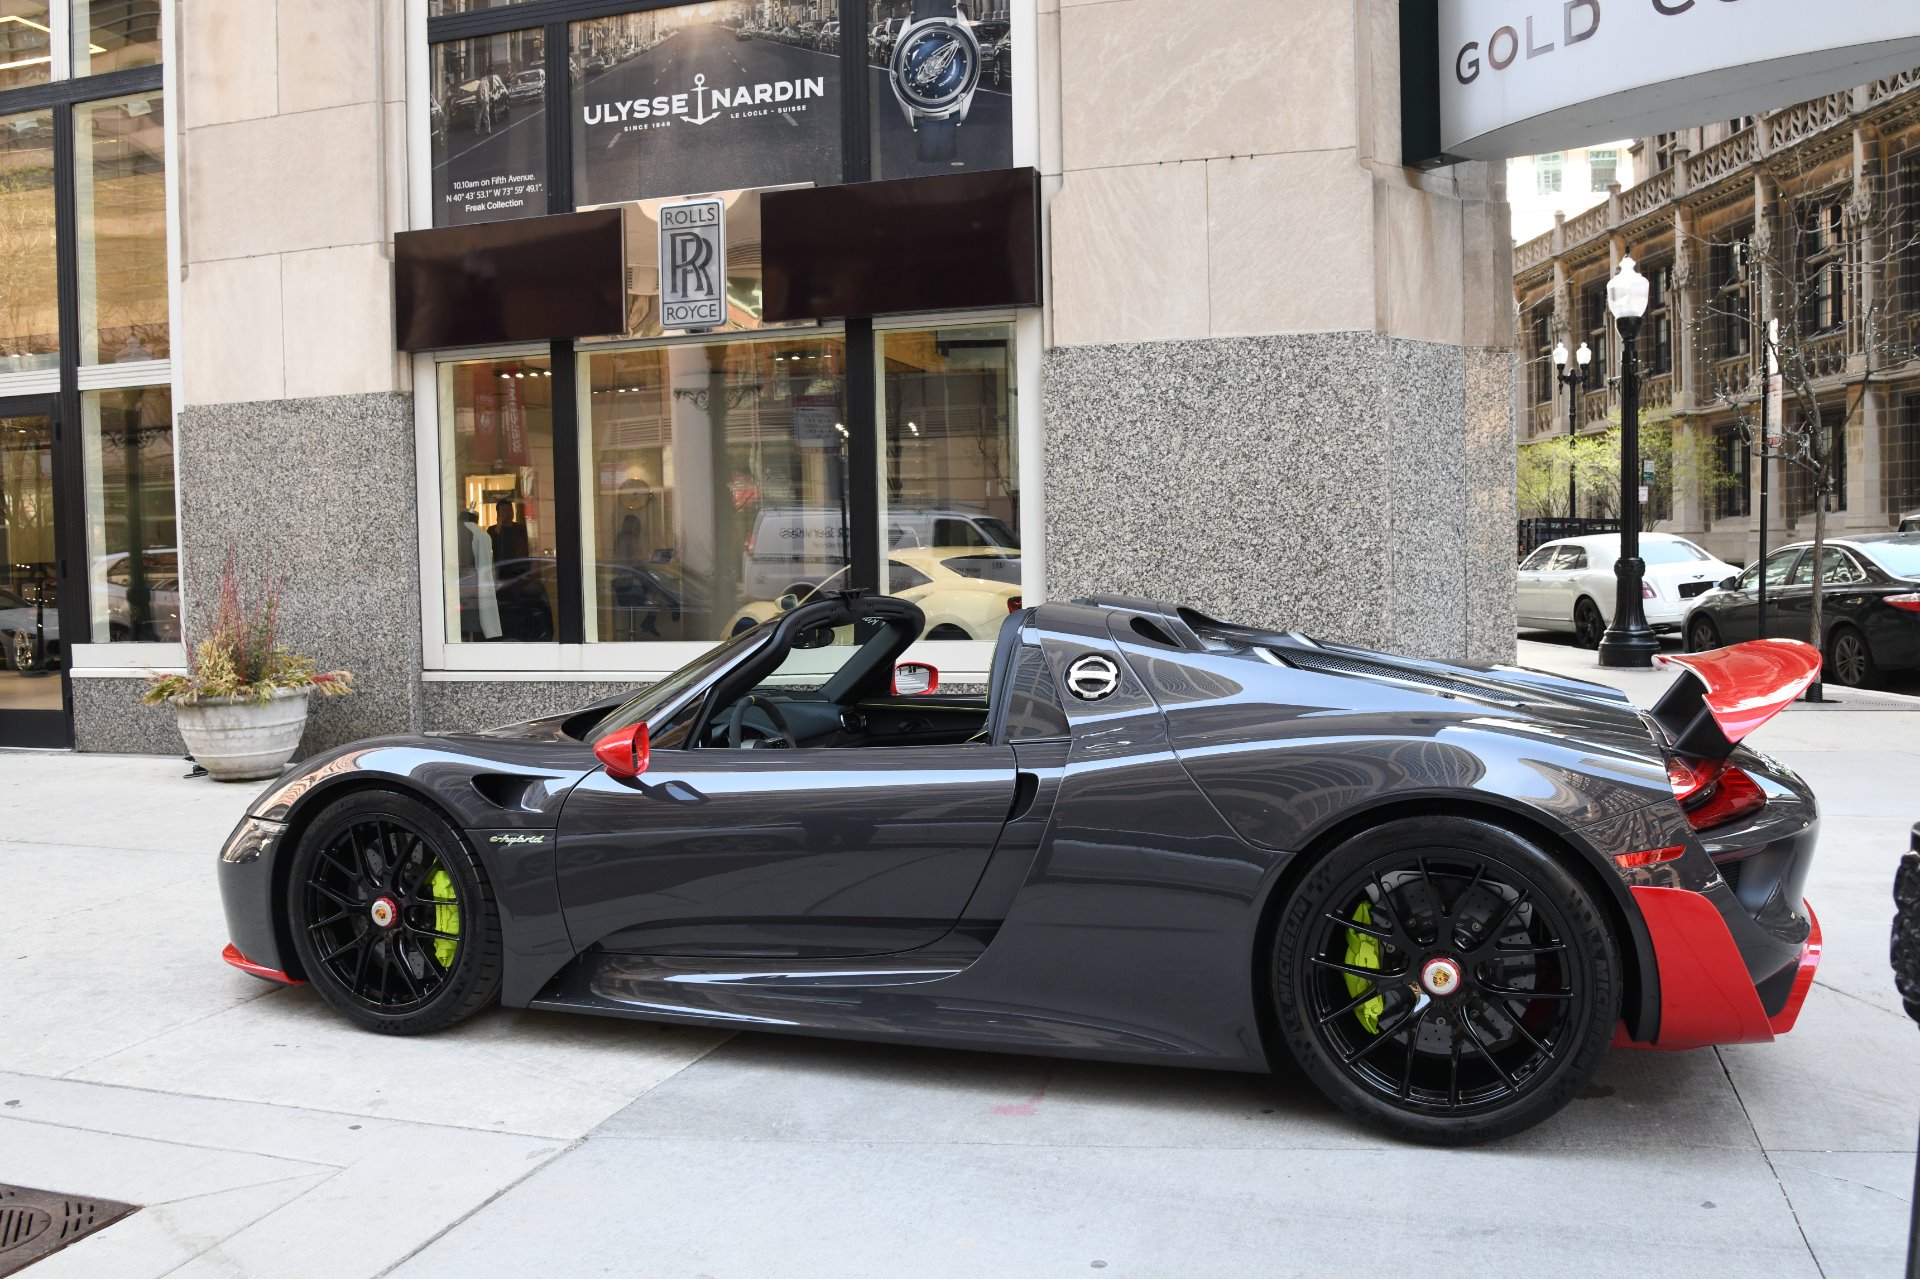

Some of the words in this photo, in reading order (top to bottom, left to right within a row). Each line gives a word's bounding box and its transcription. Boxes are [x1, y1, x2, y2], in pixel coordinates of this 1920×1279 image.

[1456, 0, 1601, 85] GOLD
[583, 93, 689, 125] ULYSSE
[711, 76, 825, 110] NARDIN
[742, 109, 768, 118] LOCLE
[777, 104, 807, 114] SUISSE
[624, 123, 649, 132] SINCE
[454, 181, 479, 190] 10.10am
[491, 176, 506, 185] Fifth
[508, 174, 535, 183] Avenue.
[493, 188, 501, 197] W
[465, 203, 485, 212] Freak
[486, 199, 524, 210] Collection
[664, 207, 716, 226] ROLLS
[666, 303, 718, 321] ROYCE
[1278, 896, 1309, 1006] MICHELIN
